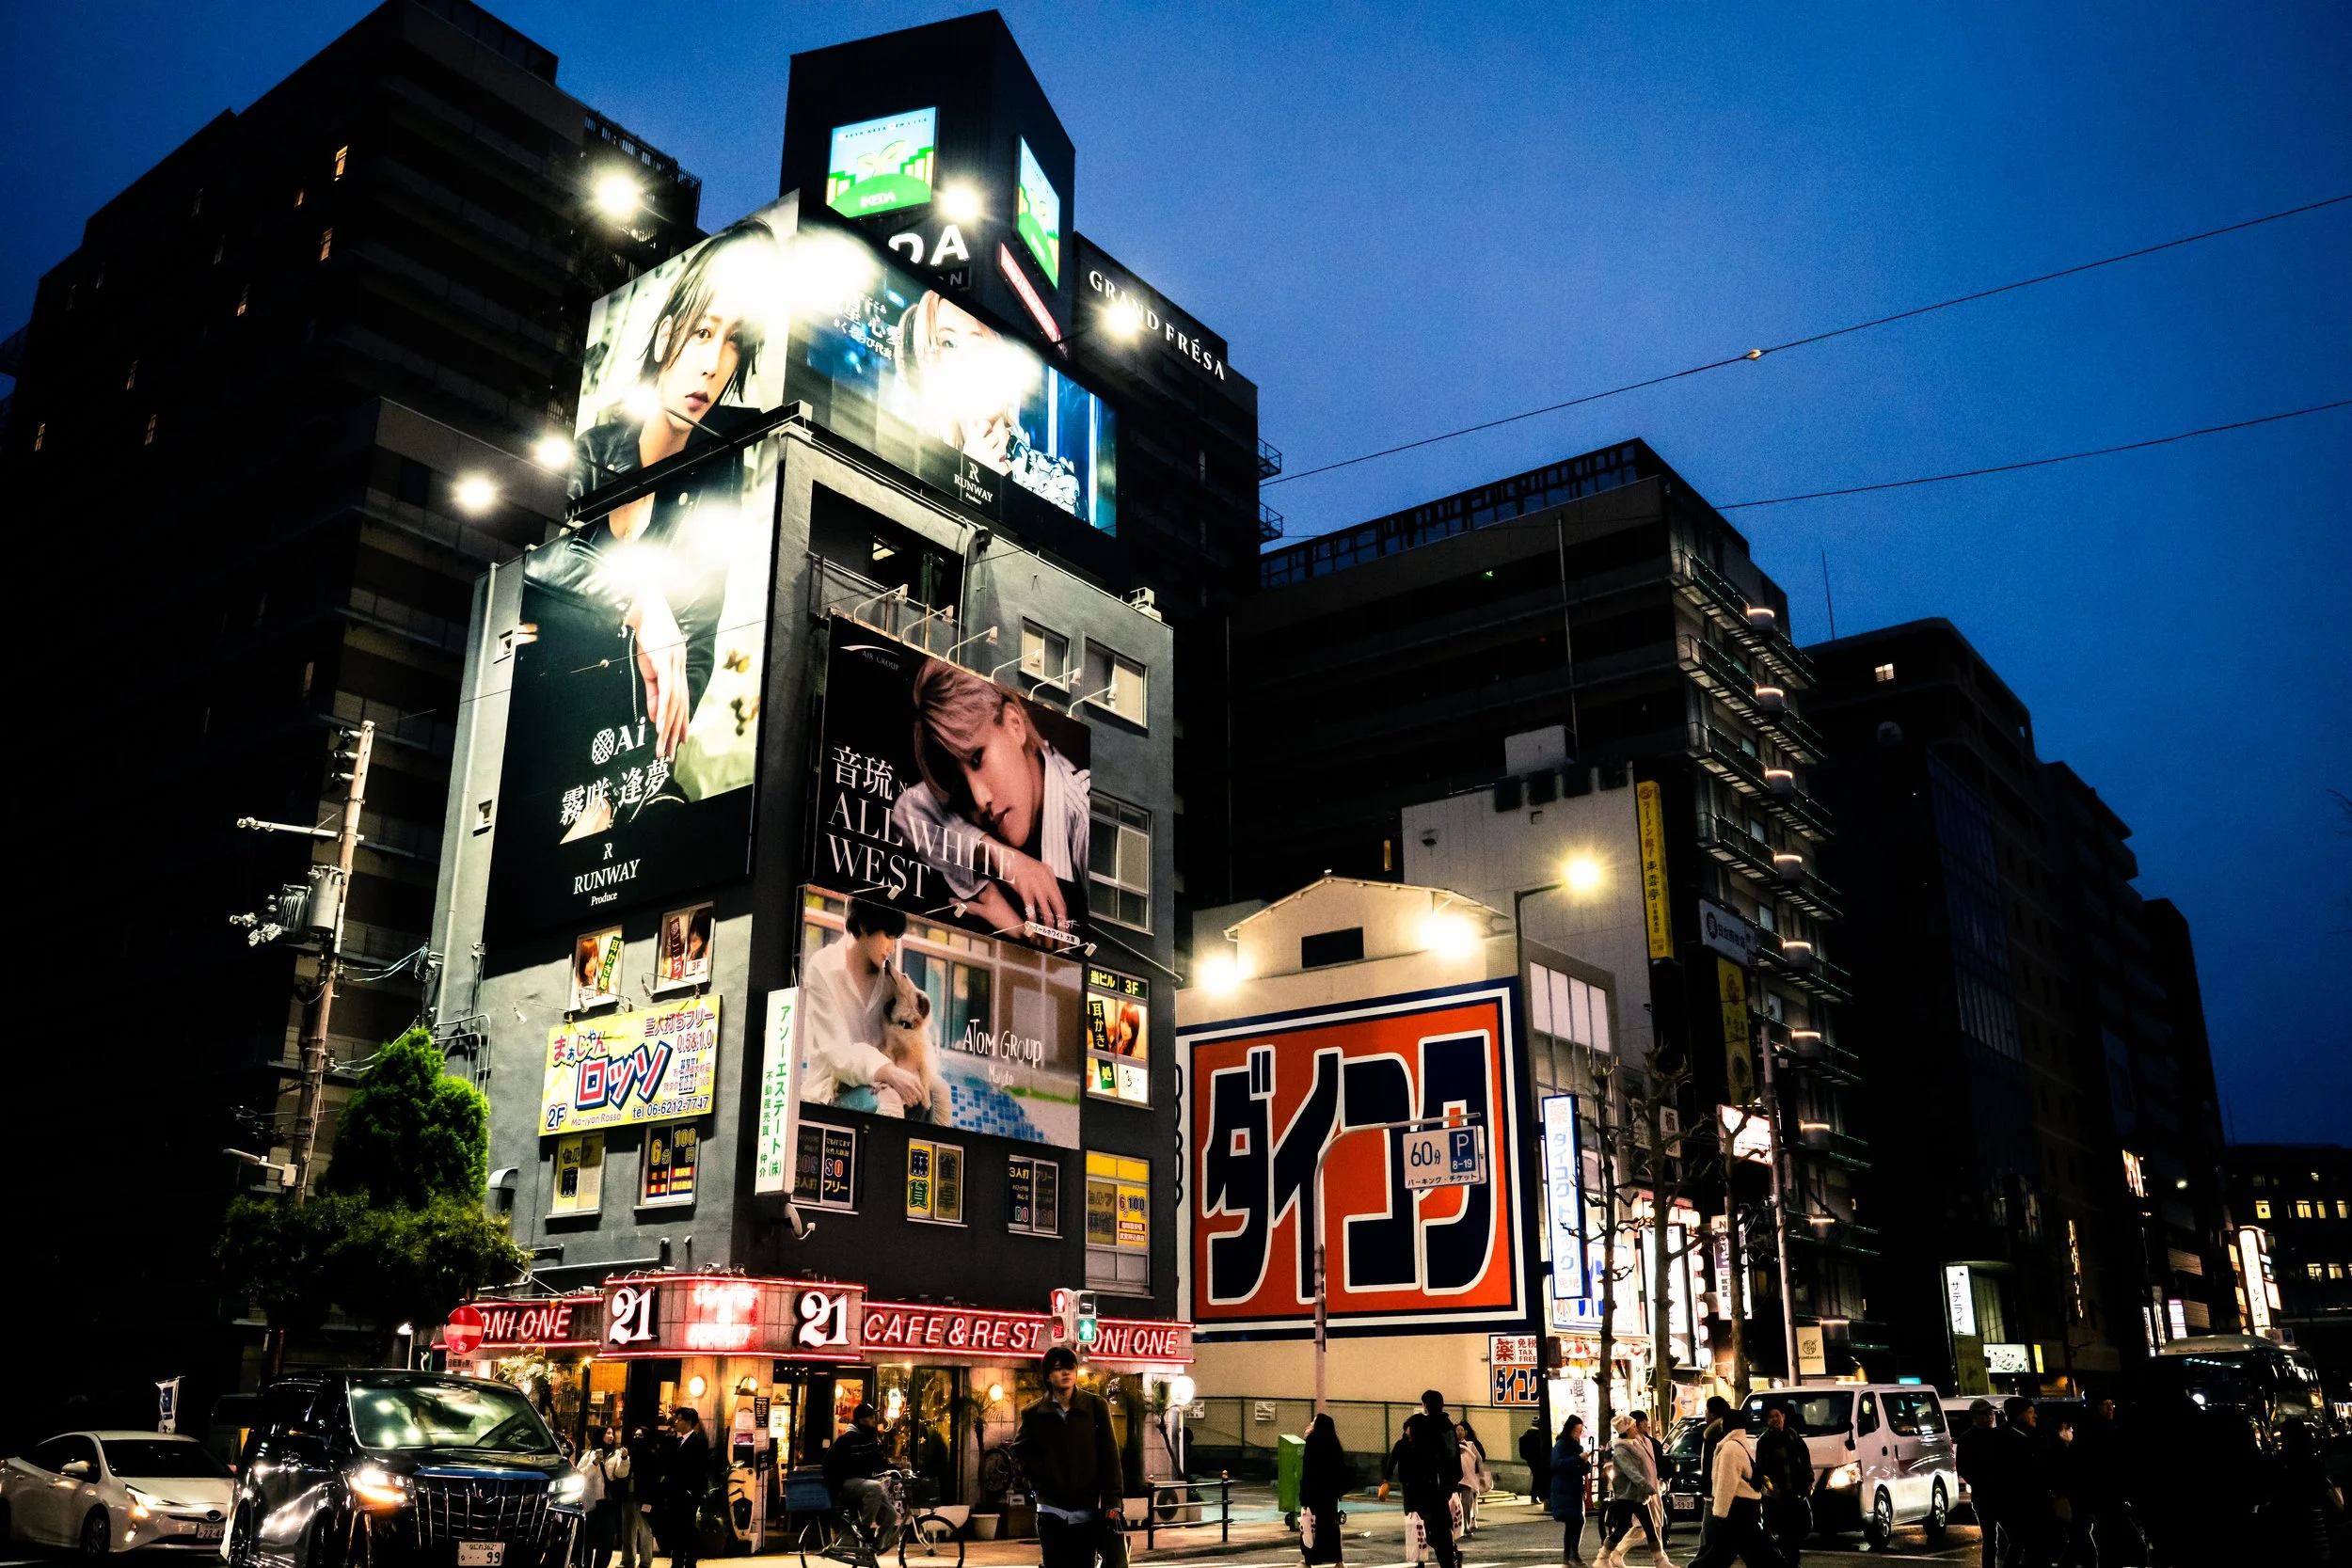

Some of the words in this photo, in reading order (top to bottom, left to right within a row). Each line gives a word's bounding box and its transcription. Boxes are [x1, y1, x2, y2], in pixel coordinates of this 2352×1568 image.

[838, 131, 864, 140] RESH
[860, 192, 896, 208] IKEDA
[1089, 270, 1159, 330] GRAND
[954, 473, 993, 503] RUNWAY
[876, 656, 899, 672] GROUP
[613, 716, 646, 755] Ai
[832, 746, 894, 800] 音琉
[827, 791, 903, 847] ALL
[906, 815, 1017, 885] WHITE
[573, 859, 641, 895] RUNWAY
[826, 833, 931, 899] WEST
[591, 892, 618, 906] Produce
[691, 961, 702, 971] 3F
[1090, 970, 1116, 989] 当ビル
[1124, 979, 1139, 995] 3F
[644, 1008, 715, 1037] 三人打ちフリー
[575, 1040, 673, 1111] ロッソ
[546, 1103, 567, 1131] 2F
[600, 1114, 621, 1124] Rosso
[632, 1106, 644, 1119] tel
[646, 1096, 709, 1117] 06-6212-7747
[1549, 1101, 1568, 1125] 薬
[1410, 1141, 1441, 1166] 60分
[1456, 1133, 1470, 1157] P
[1453, 1159, 1472, 1169] 8-19
[521, 1307, 573, 1338] ONE
[610, 1287, 655, 1344] 21
[799, 1290, 850, 1348] 21
[864, 1313, 944, 1345] CAFE
[948, 1317, 966, 1346] &
[971, 1320, 1044, 1350] REST
[1134, 1329, 1180, 1355] ONE
[1495, 1338, 1515, 1362] 薬
[1518, 1338, 1536, 1349] 免税
[1495, 1366, 1539, 1402] ダイコク
